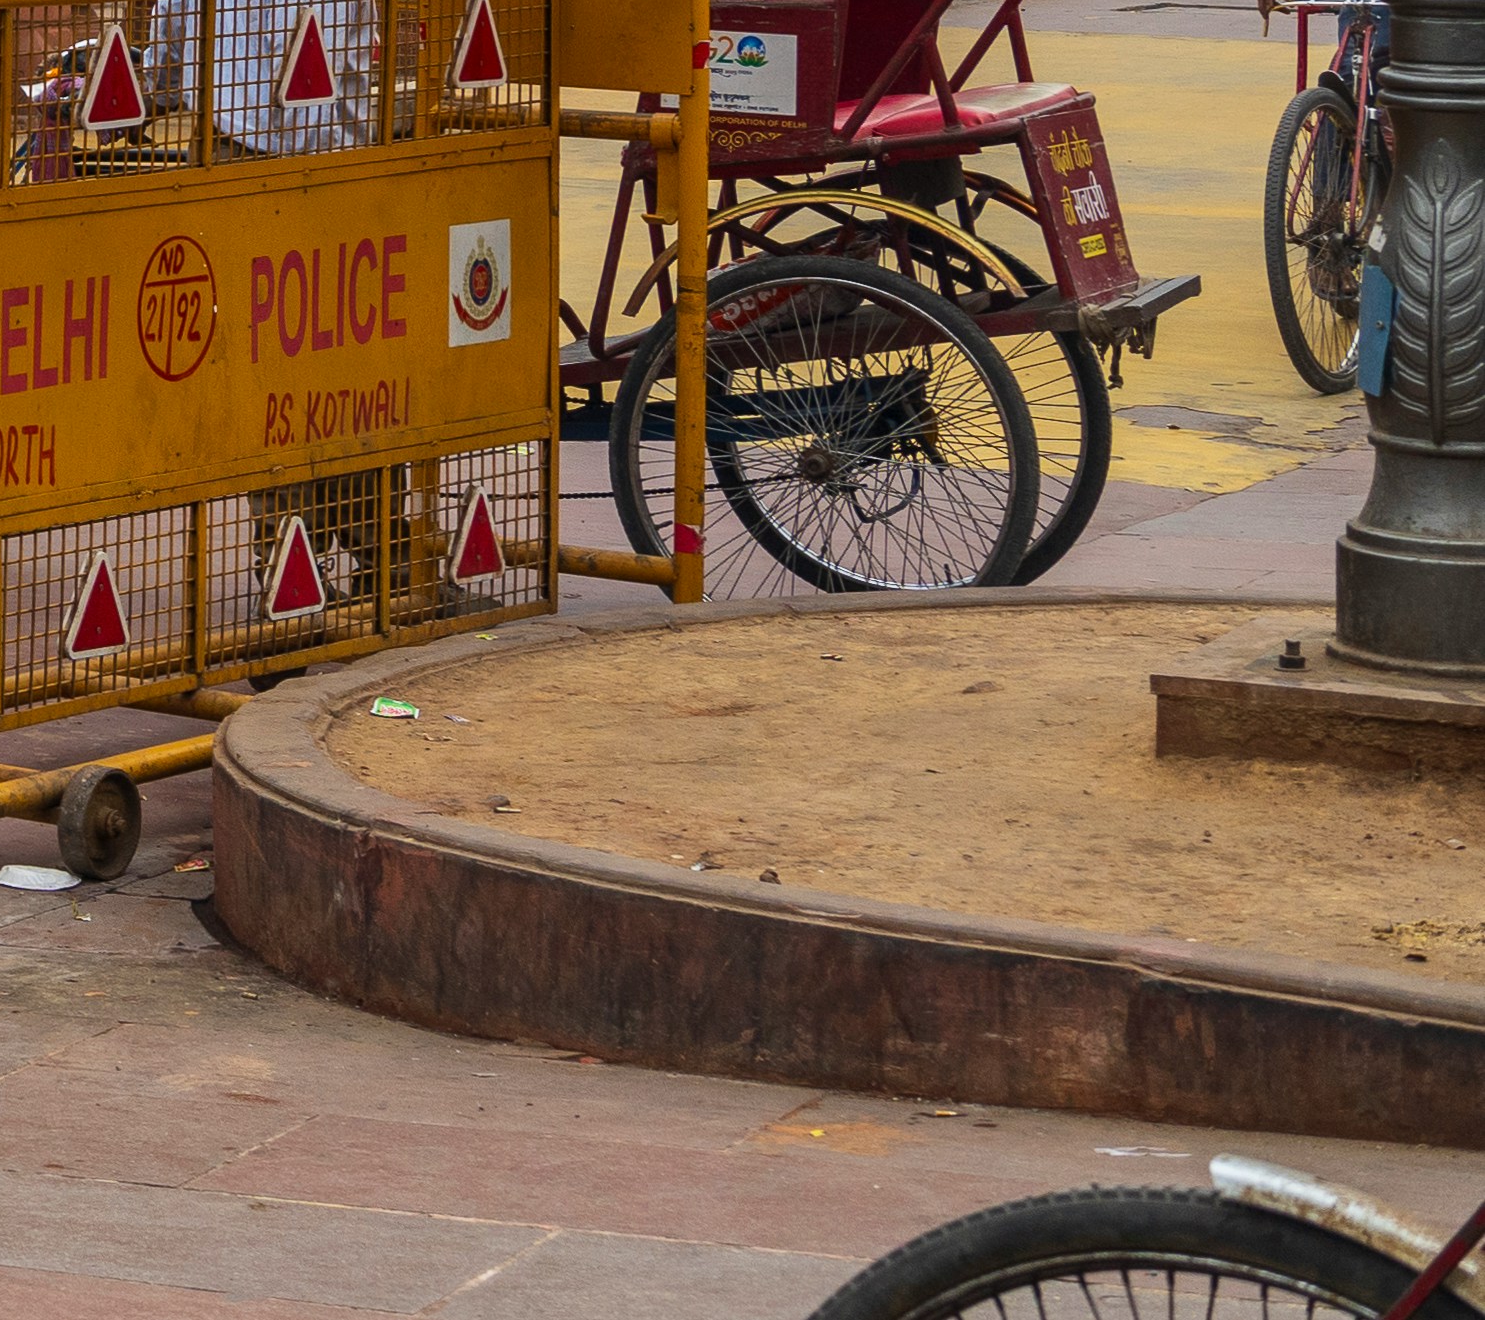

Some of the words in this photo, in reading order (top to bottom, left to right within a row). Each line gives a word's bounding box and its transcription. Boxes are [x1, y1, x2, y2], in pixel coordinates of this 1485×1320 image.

[710, 115, 765, 128] ORPORATION
[768, 120, 780, 128] OF
[781, 120, 808, 129] DELHI
[157, 244, 185, 276] ND
[144, 291, 165, 343] 21
[175, 289, 202, 342] 92
[250, 234, 407, 364] POLICE
[305, 376, 410, 444] KOTWALI
